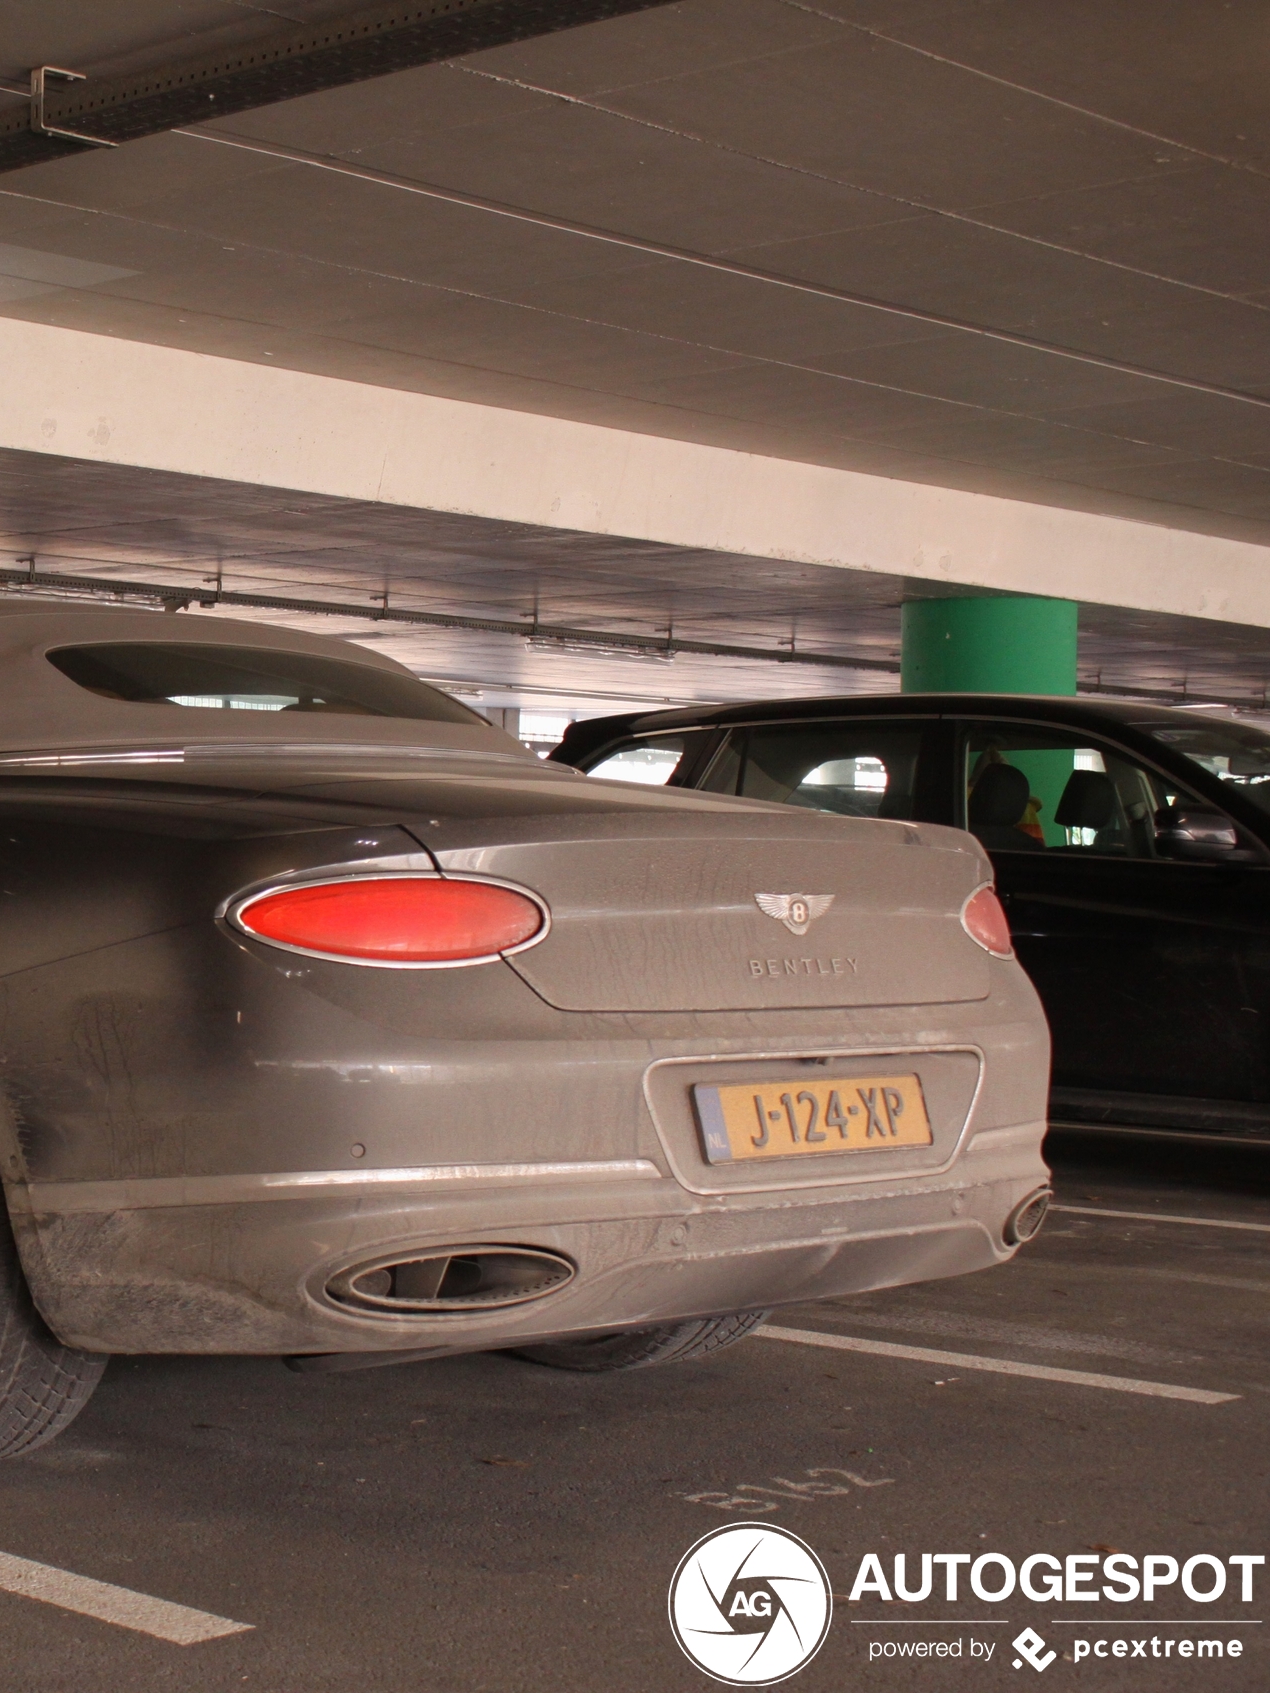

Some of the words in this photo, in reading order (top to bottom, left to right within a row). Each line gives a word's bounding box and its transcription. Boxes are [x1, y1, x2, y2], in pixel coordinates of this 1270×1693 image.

[749, 957, 858, 977] BENTLEY
[750, 1086, 905, 1147] J-124-XP
[708, 1132, 727, 1149] NL
